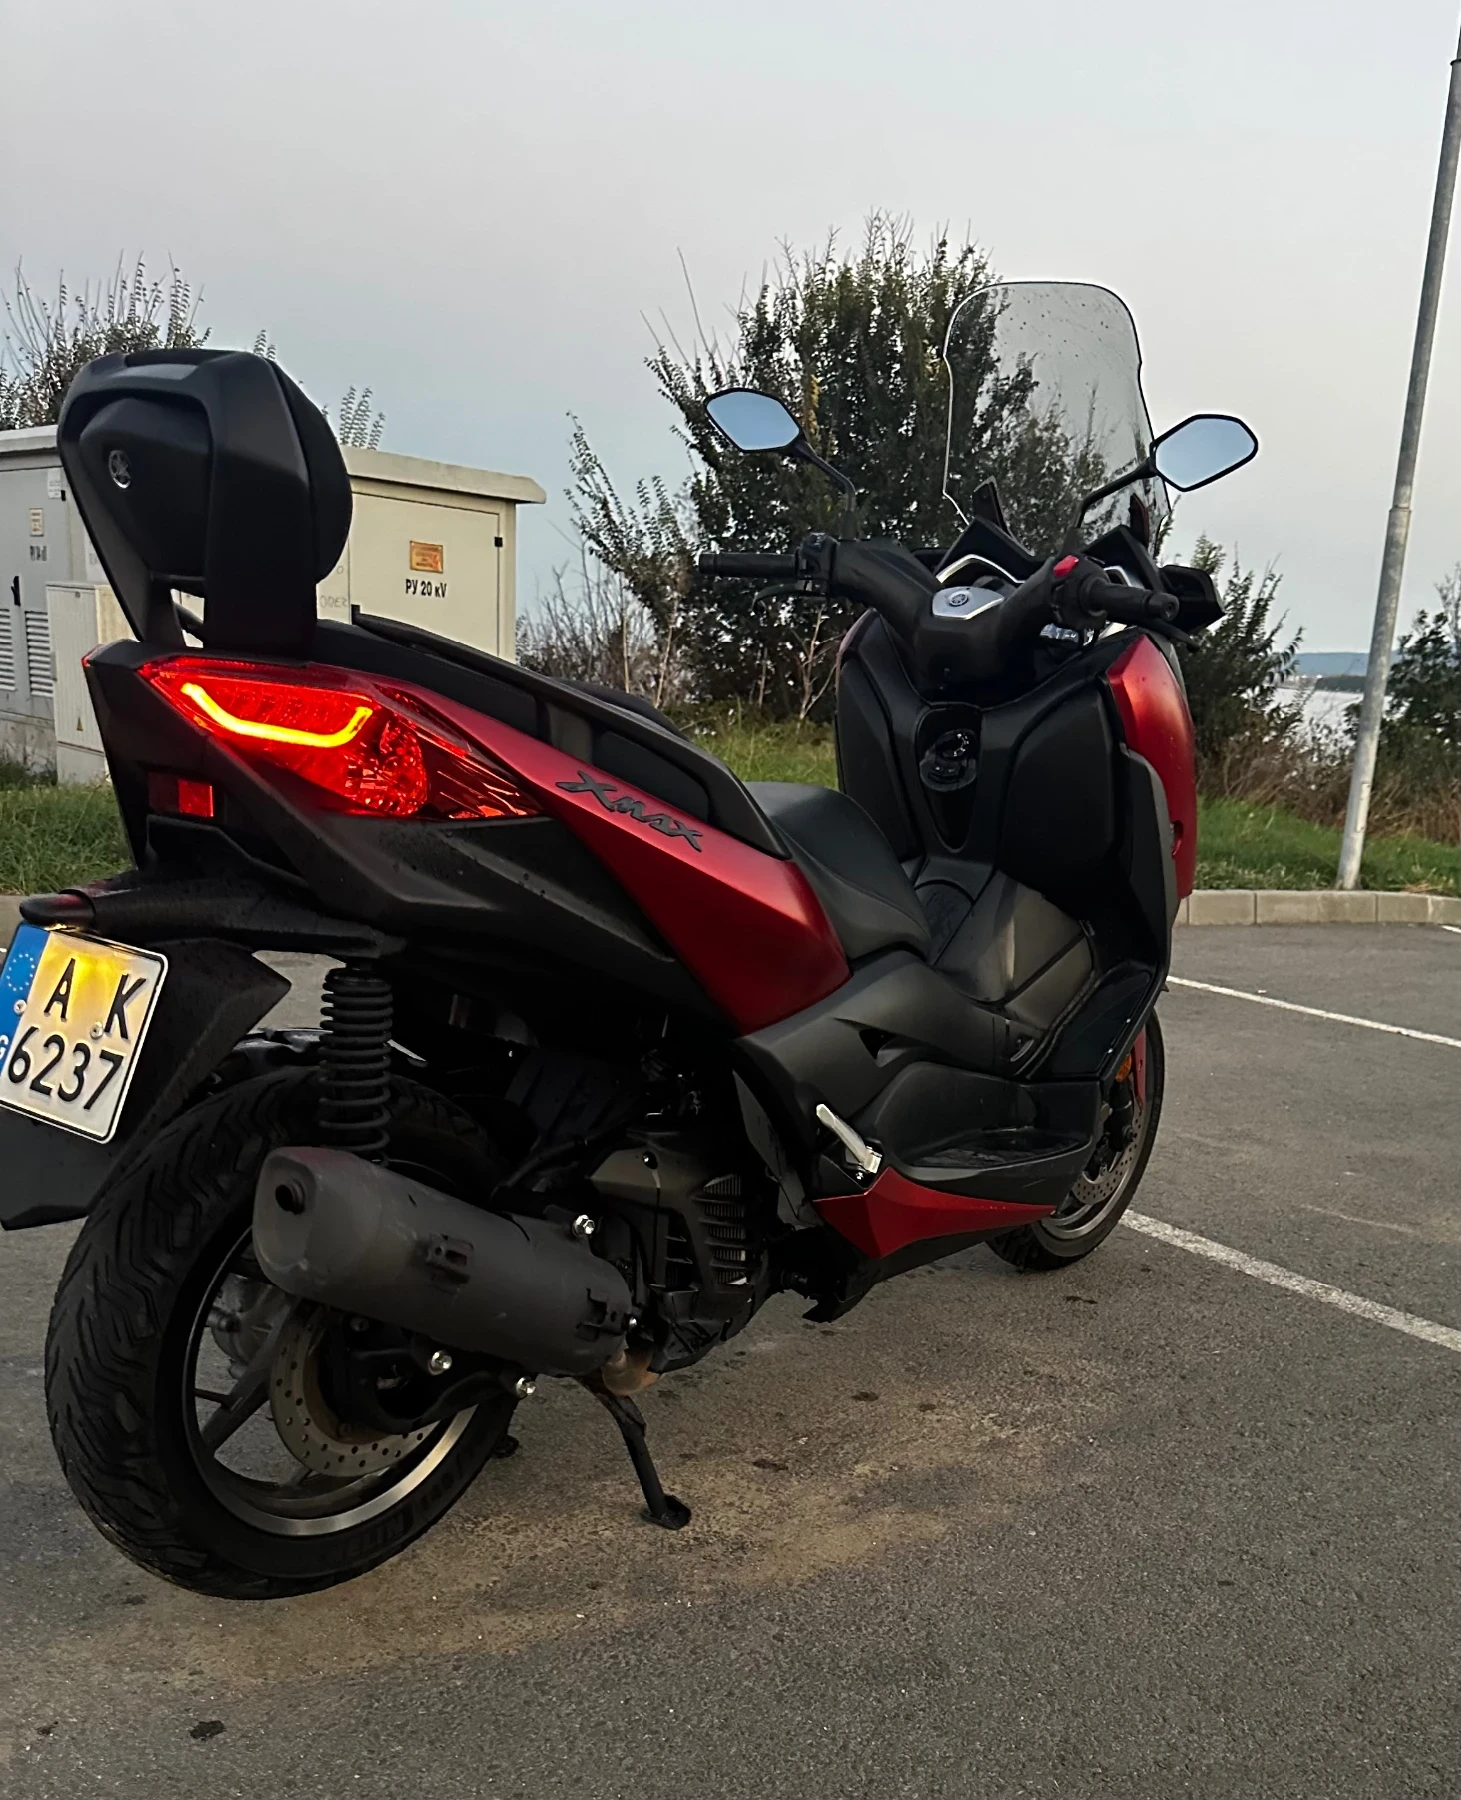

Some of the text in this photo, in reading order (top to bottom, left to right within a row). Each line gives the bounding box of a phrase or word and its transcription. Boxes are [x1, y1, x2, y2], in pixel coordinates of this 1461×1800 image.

[420, 580, 433, 597] 20
[44, 958, 147, 1040] A K
[8, 1026, 124, 1111] 6237
